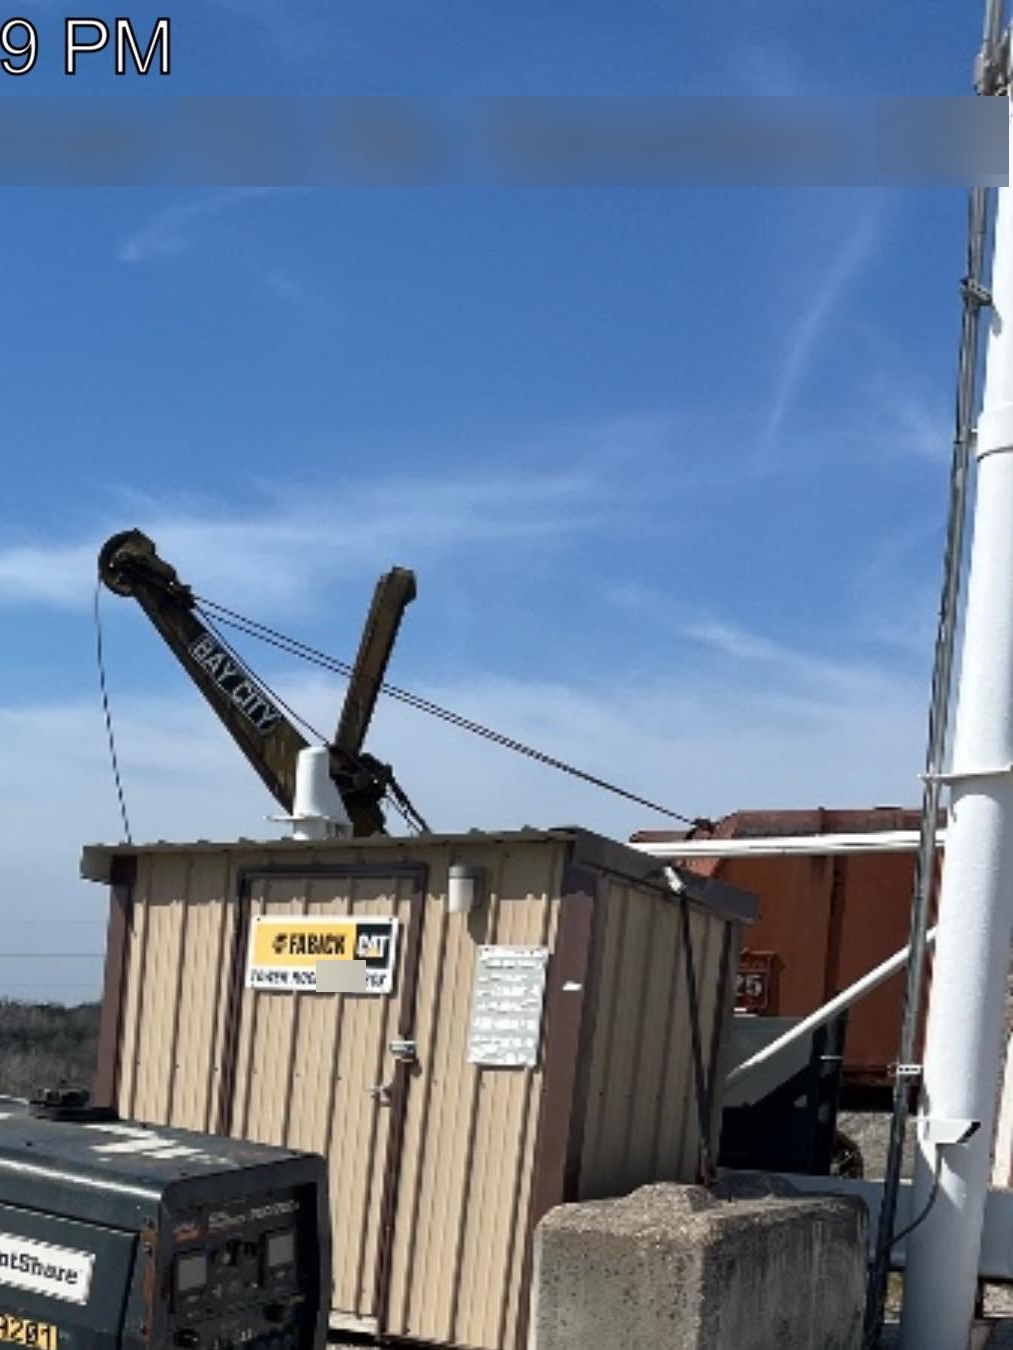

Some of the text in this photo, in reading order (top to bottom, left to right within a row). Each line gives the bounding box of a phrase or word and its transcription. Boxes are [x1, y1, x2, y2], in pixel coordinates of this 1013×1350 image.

[191, 640, 281, 728] BAY CITY
[289, 932, 390, 958] FABICK CAT
